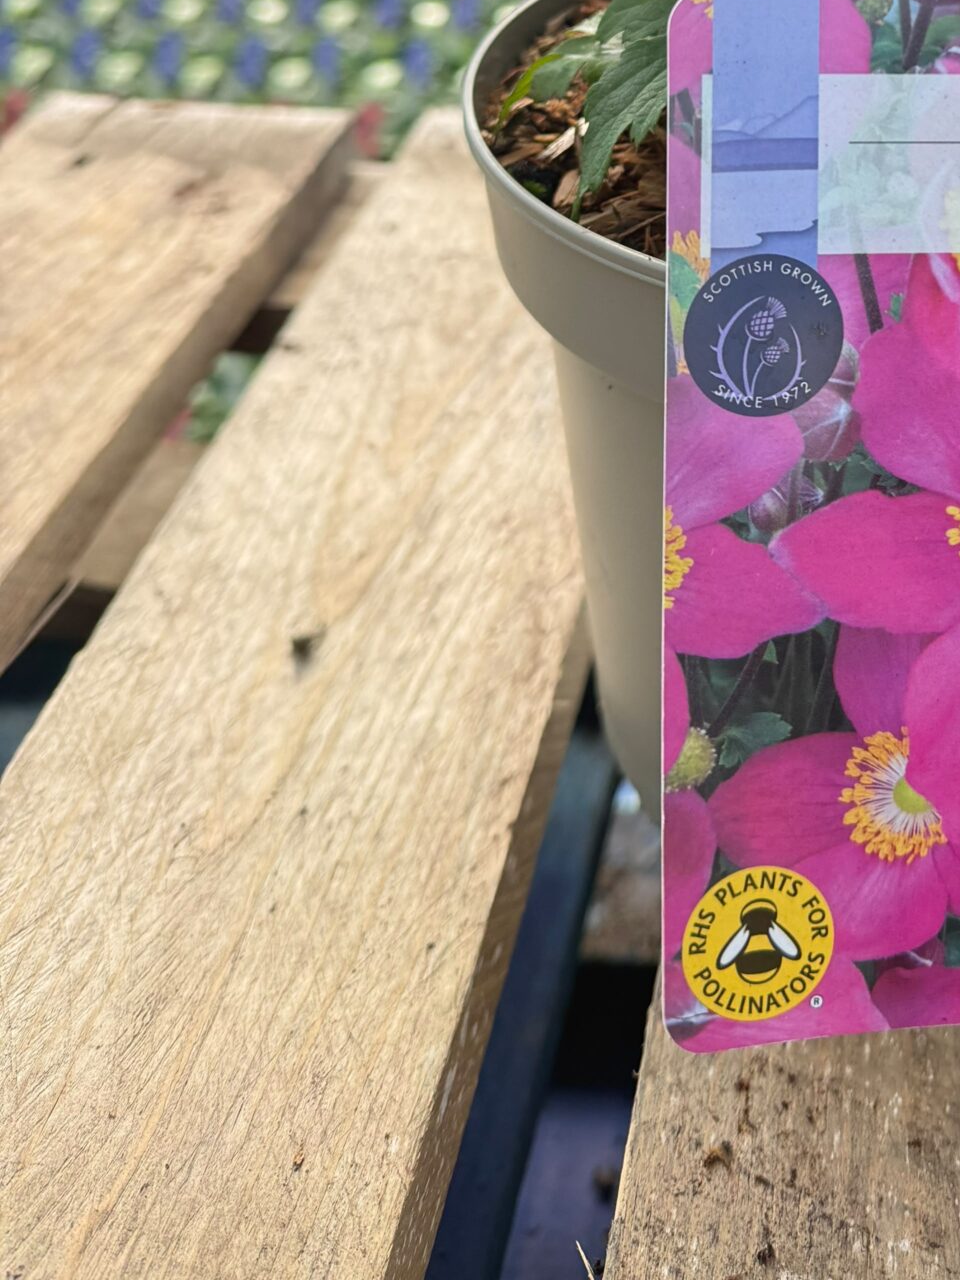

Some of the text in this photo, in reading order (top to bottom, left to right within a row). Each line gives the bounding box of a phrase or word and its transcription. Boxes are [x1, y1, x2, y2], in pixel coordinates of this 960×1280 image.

[703, 260, 832, 307] SCOTTISH GROWN
[714, 381, 812, 409] SINCE 1972
[688, 871, 829, 955] RHS PLANTS FOR
[693, 952, 825, 1015] POLLINATORS
